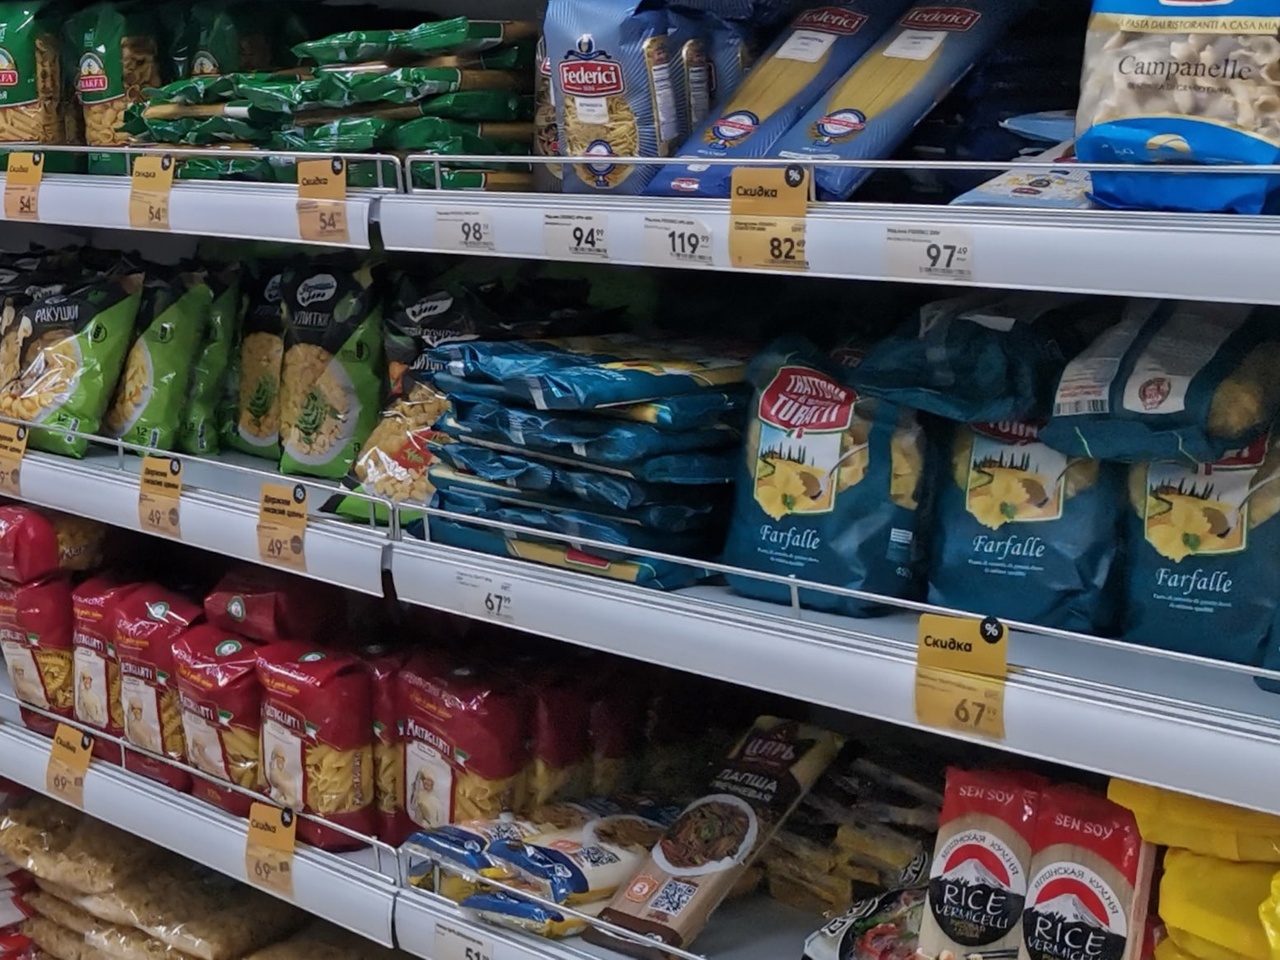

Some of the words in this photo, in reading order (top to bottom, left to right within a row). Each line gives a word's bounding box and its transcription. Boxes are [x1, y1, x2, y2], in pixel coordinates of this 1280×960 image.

[1230, 20, 1251, 31] CASA
[1254, 20, 1278, 31] MIA
[563, 66, 617, 85] Federici
[1119, 53, 1253, 82] Campanelle
[736, 185, 778, 199] Скидка
[148, 205, 162, 222] 54
[320, 212, 336, 230] 54
[461, 222, 483, 241] 98
[572, 226, 596, 248] 94
[668, 230, 700, 254] 119
[770, 237, 796, 261] 82
[926, 243, 956, 268] 97
[34, 305, 79, 323] РАКУШКИ
[267, 538, 283, 557] 49
[760, 524, 820, 550] Farfalle
[973, 534, 1045, 560] Farfalle
[1155, 567, 1233, 596] Farfalle
[485, 592, 503, 613] 67
[924, 635, 973, 653] Скидка
[954, 698, 986, 727] 67
[959, 786, 984, 800] SEN
[986, 792, 1014, 806] SOY
[1055, 813, 1081, 831] SEN
[1083, 823, 1114, 840] SOY
[943, 884, 1006, 915] RICE
[1034, 916, 1106, 955] RICE
